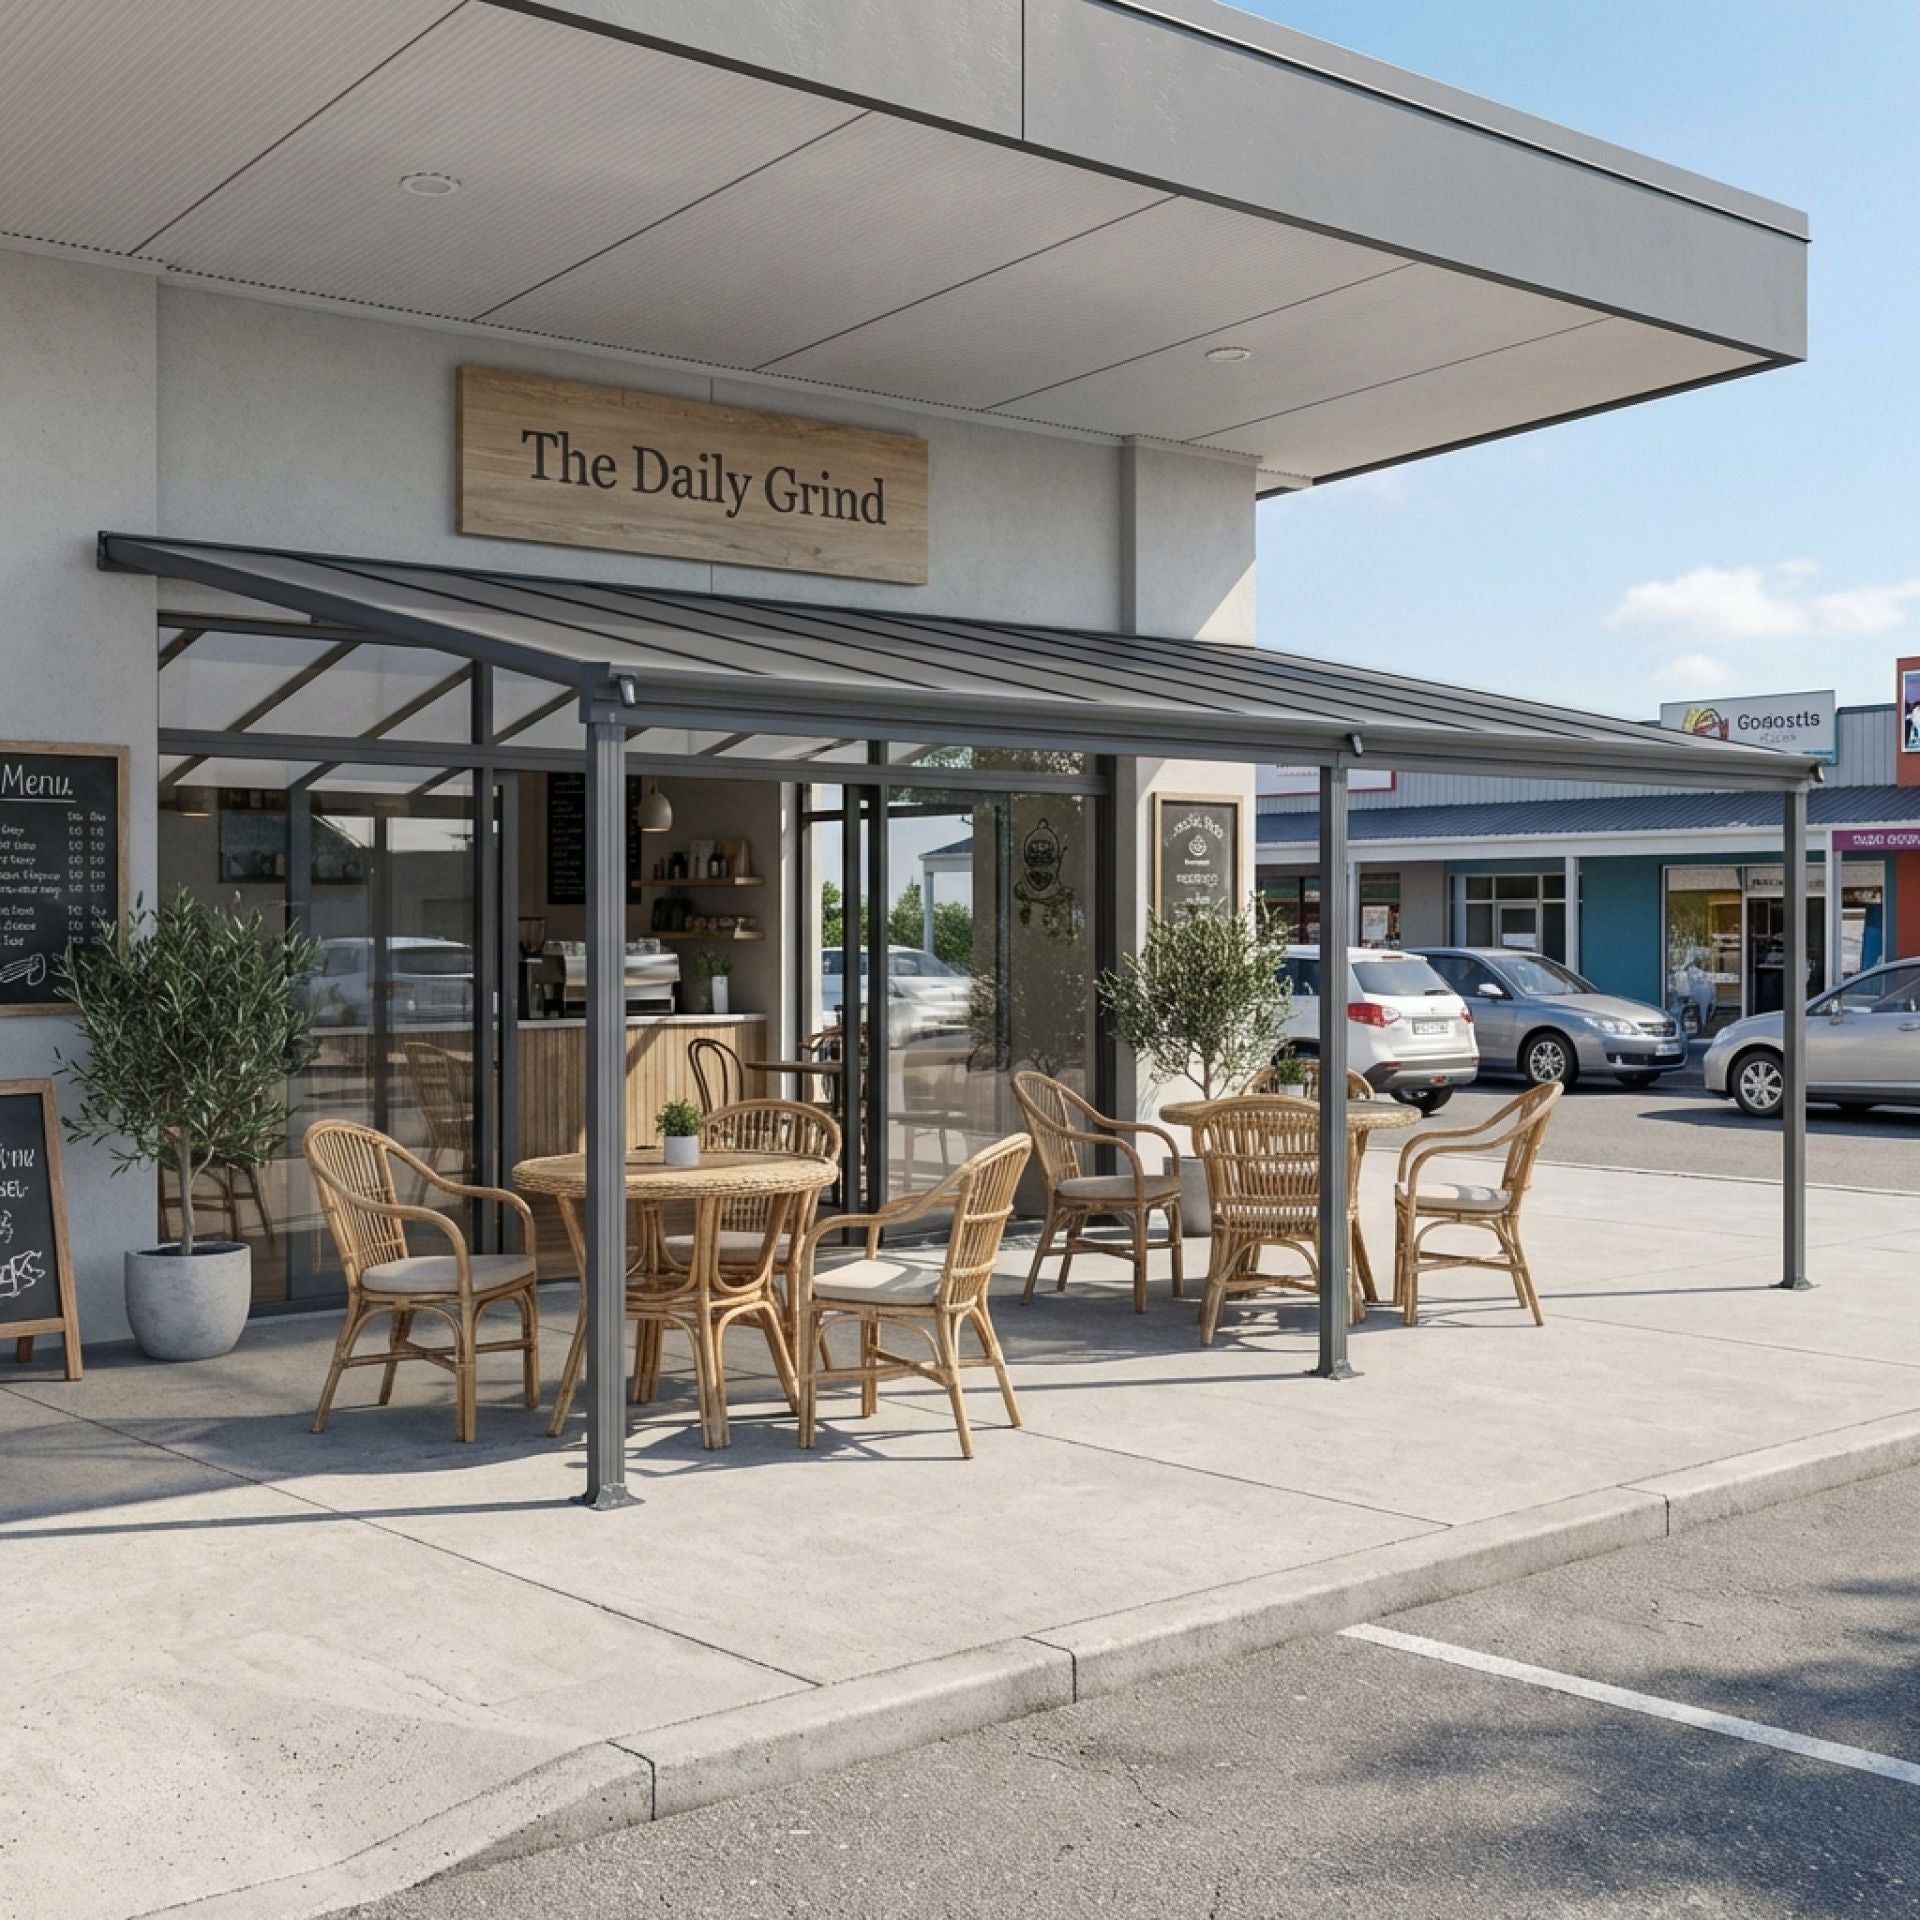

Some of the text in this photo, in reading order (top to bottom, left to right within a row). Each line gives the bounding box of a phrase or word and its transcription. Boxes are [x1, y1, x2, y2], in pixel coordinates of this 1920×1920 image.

[521, 430, 887, 525] The Daily Grind
